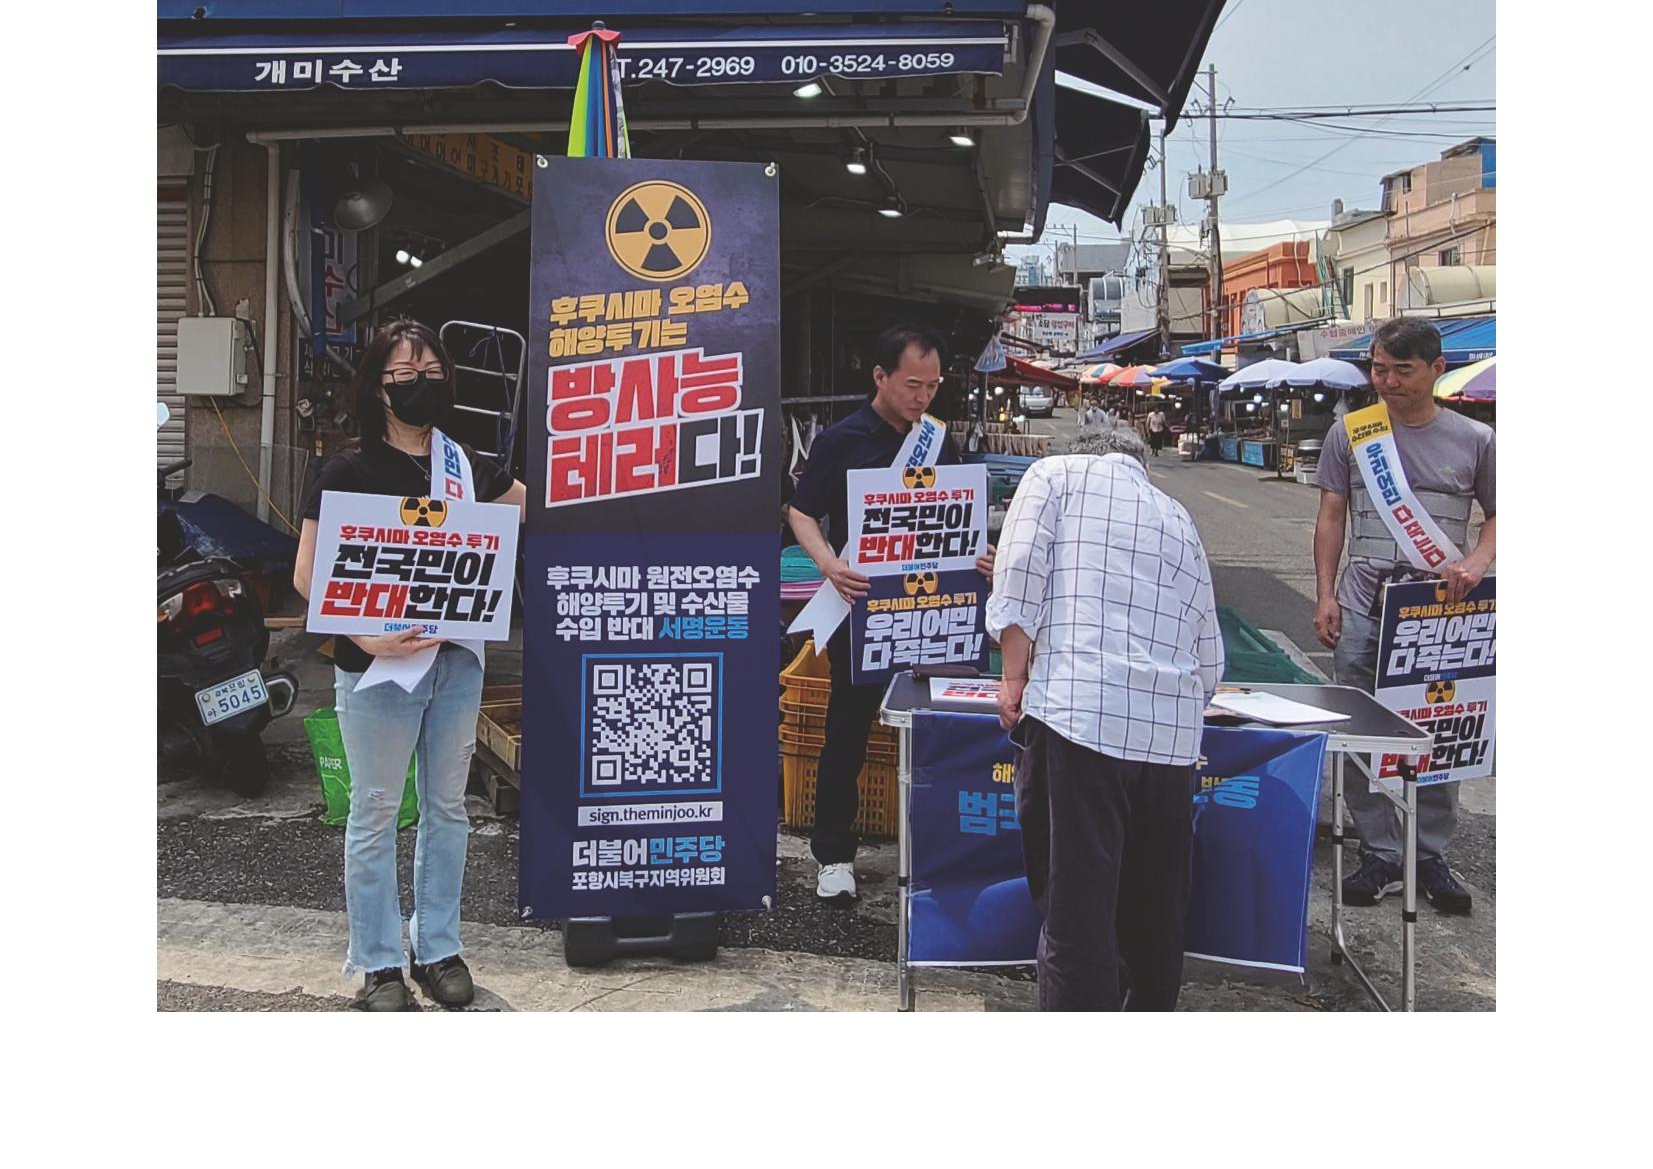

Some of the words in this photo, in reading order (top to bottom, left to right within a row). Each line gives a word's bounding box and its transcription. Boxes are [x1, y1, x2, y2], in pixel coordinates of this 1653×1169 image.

[255, 58, 402, 84] 개미수산
[781, 53, 955, 74] 010-3524-8059
[550, 288, 661, 326] 후쿠시마
[668, 281, 749, 316] 오염수
[549, 318, 688, 358] 해양투기는
[547, 348, 742, 435] 방사능
[546, 408, 764, 508] 테러다!
[864, 492, 912, 506] 후쿠시마
[914, 490, 948, 503] 오염수
[951, 489, 974, 502] 투기
[862, 503, 973, 535] 전국민이
[340, 525, 410, 544] 후쿠시마
[412, 530, 463, 548] 오염수
[466, 533, 499, 550] 투기
[858, 530, 980, 564] 반대한다!
[331, 543, 497, 586] 전국민이
[546, 566, 641, 590] 후쿠시마
[647, 565, 760, 590] 원전오염수
[320, 581, 503, 622] 반대한다!
[556, 592, 648, 616] 해양투기
[653, 592, 676, 615] 및
[680, 591, 749, 615] 수산물
[867, 597, 915, 612] 후쿠시마
[954, 592, 977, 605] 투기
[384, 623, 438, 633] 더불어주당
[555, 617, 601, 641] 수입
[607, 617, 654, 641] 반대
[658, 616, 749, 640] 서명운동
[589, 805, 713, 825] sign.theminjoo.kr
[572, 834, 726, 867] 더불어민주당
[571, 866, 726, 891] 포항시북구지역위원회
